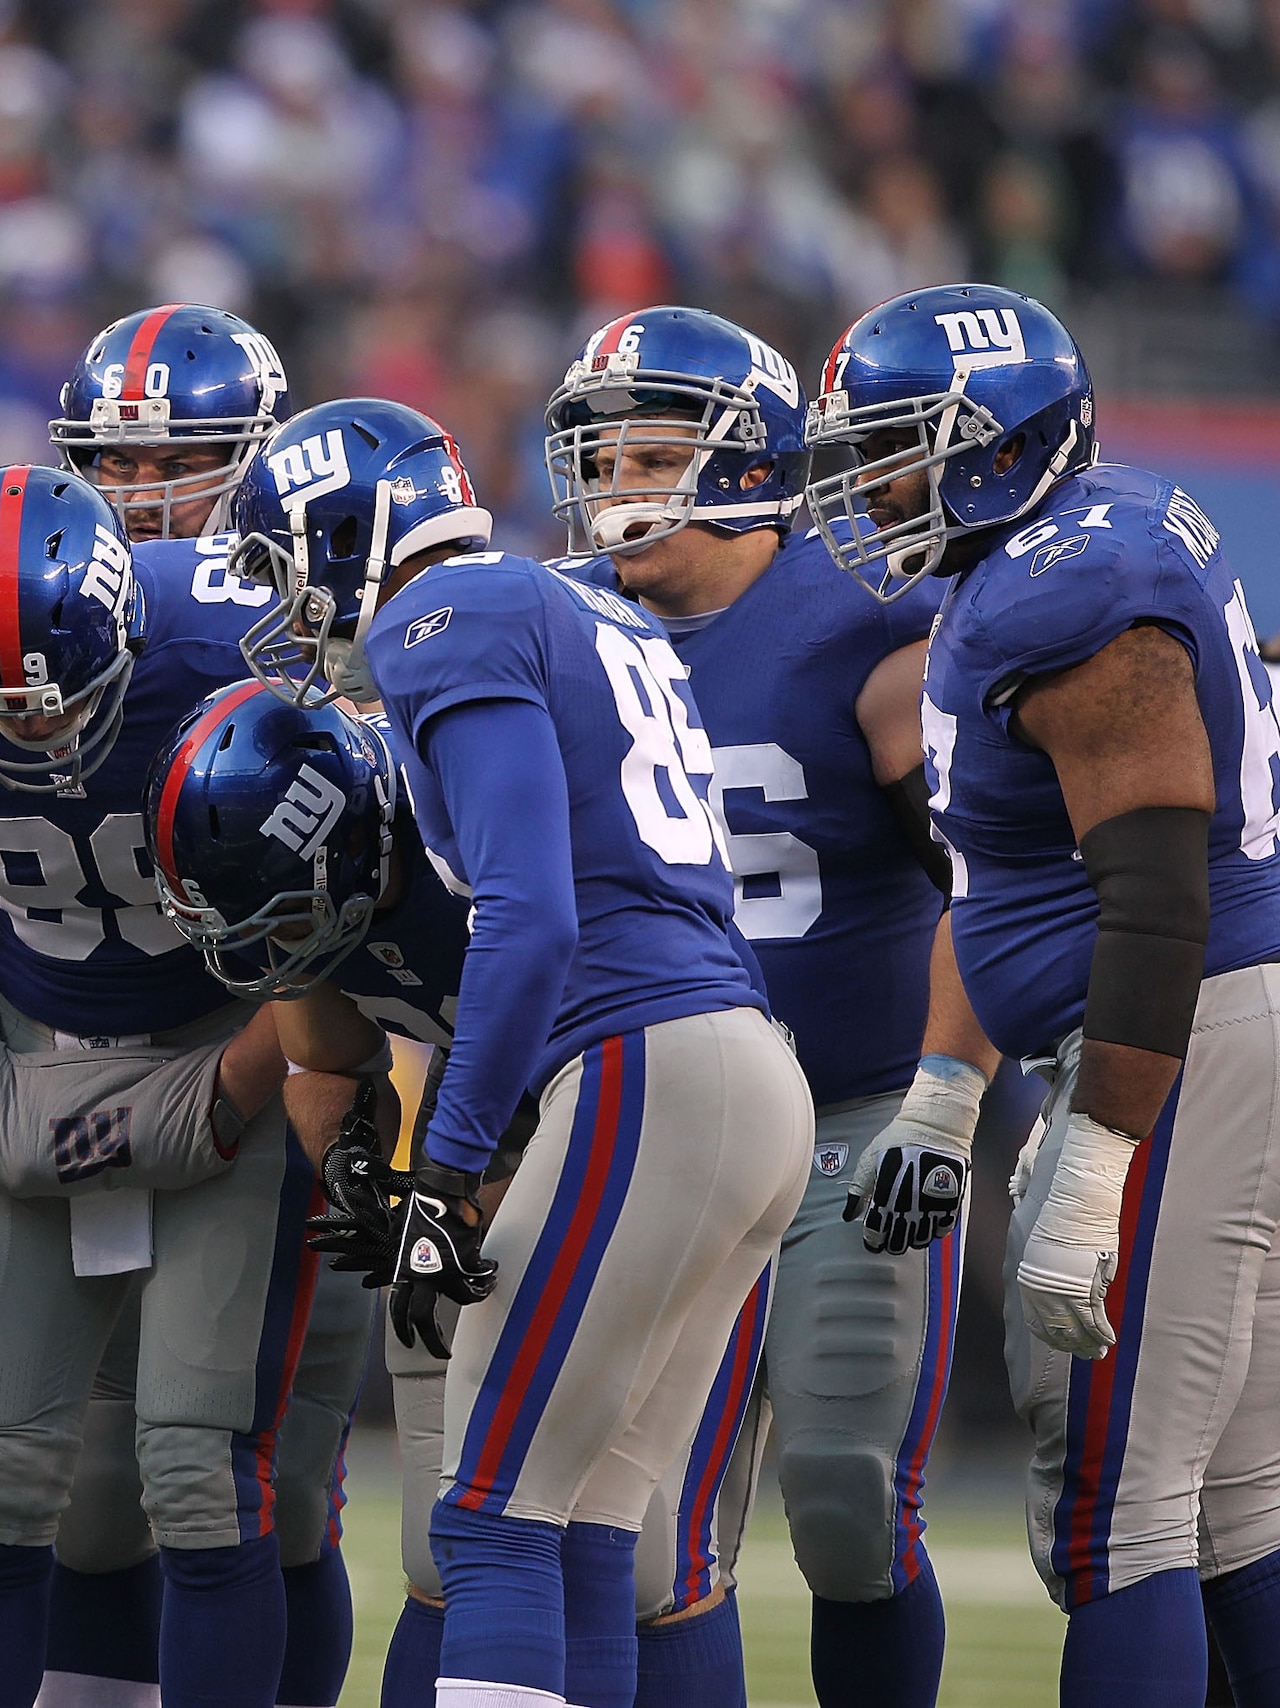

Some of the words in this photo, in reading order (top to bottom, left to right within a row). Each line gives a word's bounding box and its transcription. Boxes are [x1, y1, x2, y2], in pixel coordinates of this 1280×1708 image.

[933, 308, 1027, 370] ny
[102, 363, 170, 399] 60
[267, 429, 351, 513] ny
[259, 763, 347, 862] ny
